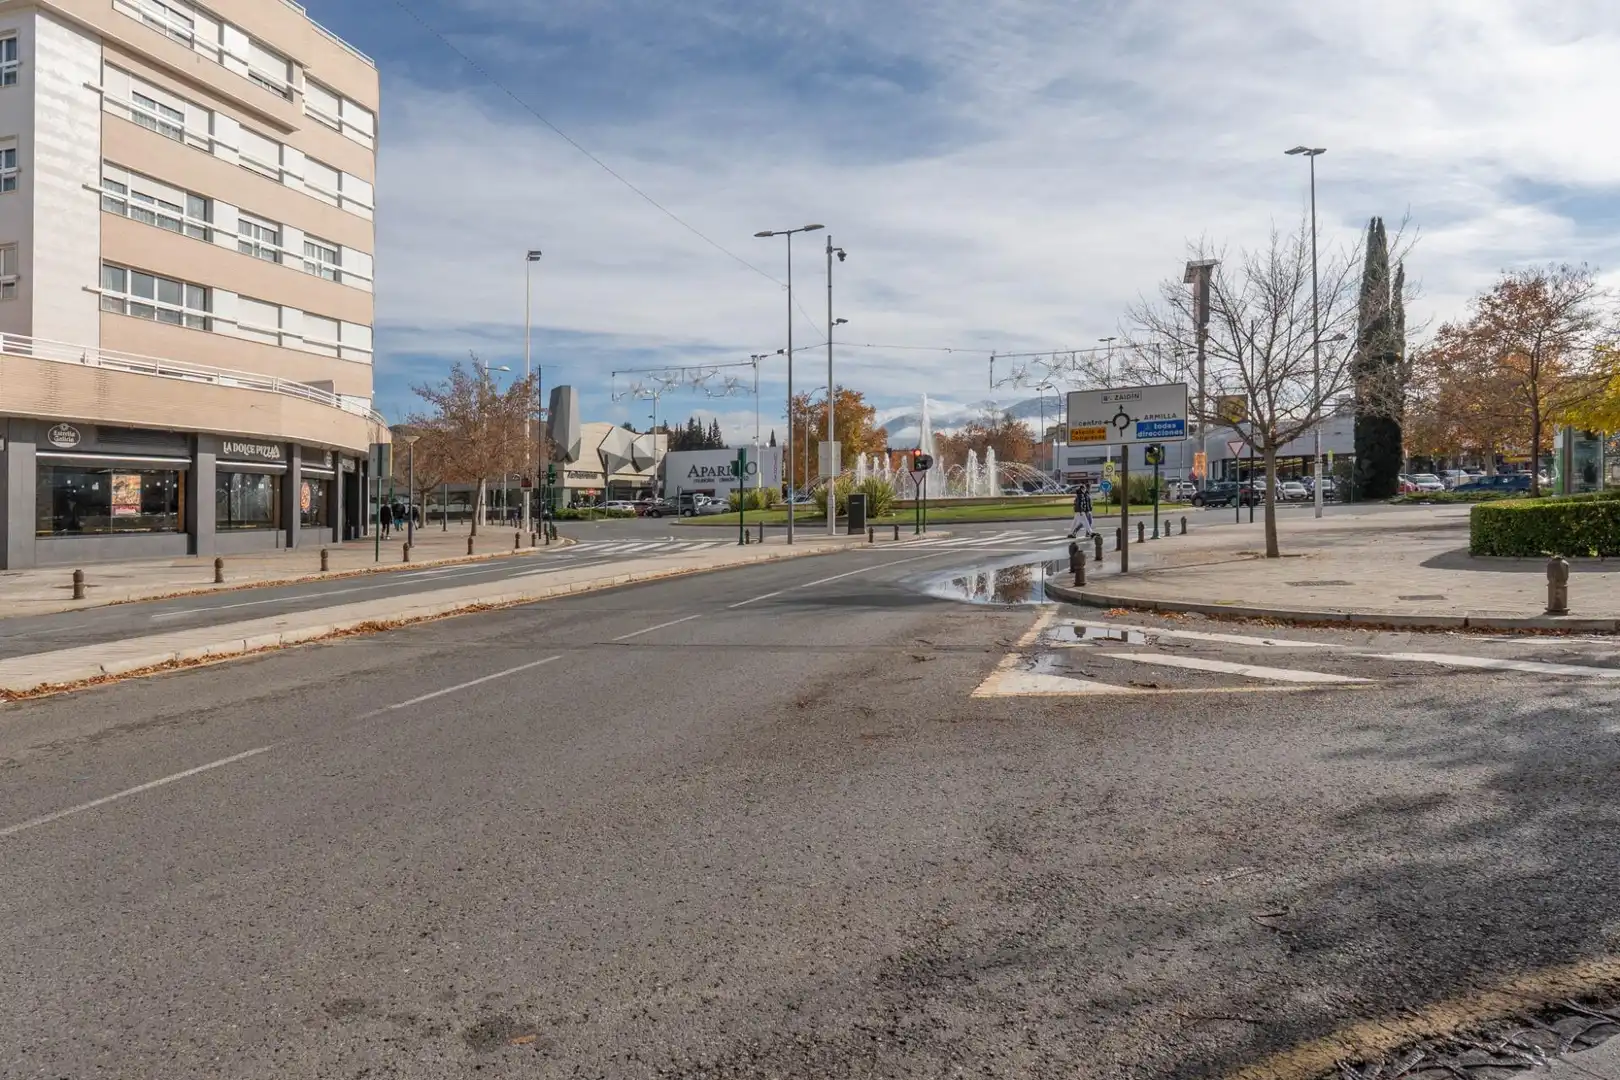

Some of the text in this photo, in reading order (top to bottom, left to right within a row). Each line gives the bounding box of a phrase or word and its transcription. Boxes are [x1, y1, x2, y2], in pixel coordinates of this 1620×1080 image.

[1144, 412, 1177, 421] ARMILLA
[1137, 429, 1183, 438] direcciones
[223, 442, 280, 459] LA DOLCE PIZZA
[687, 461, 757, 478] APARIO
